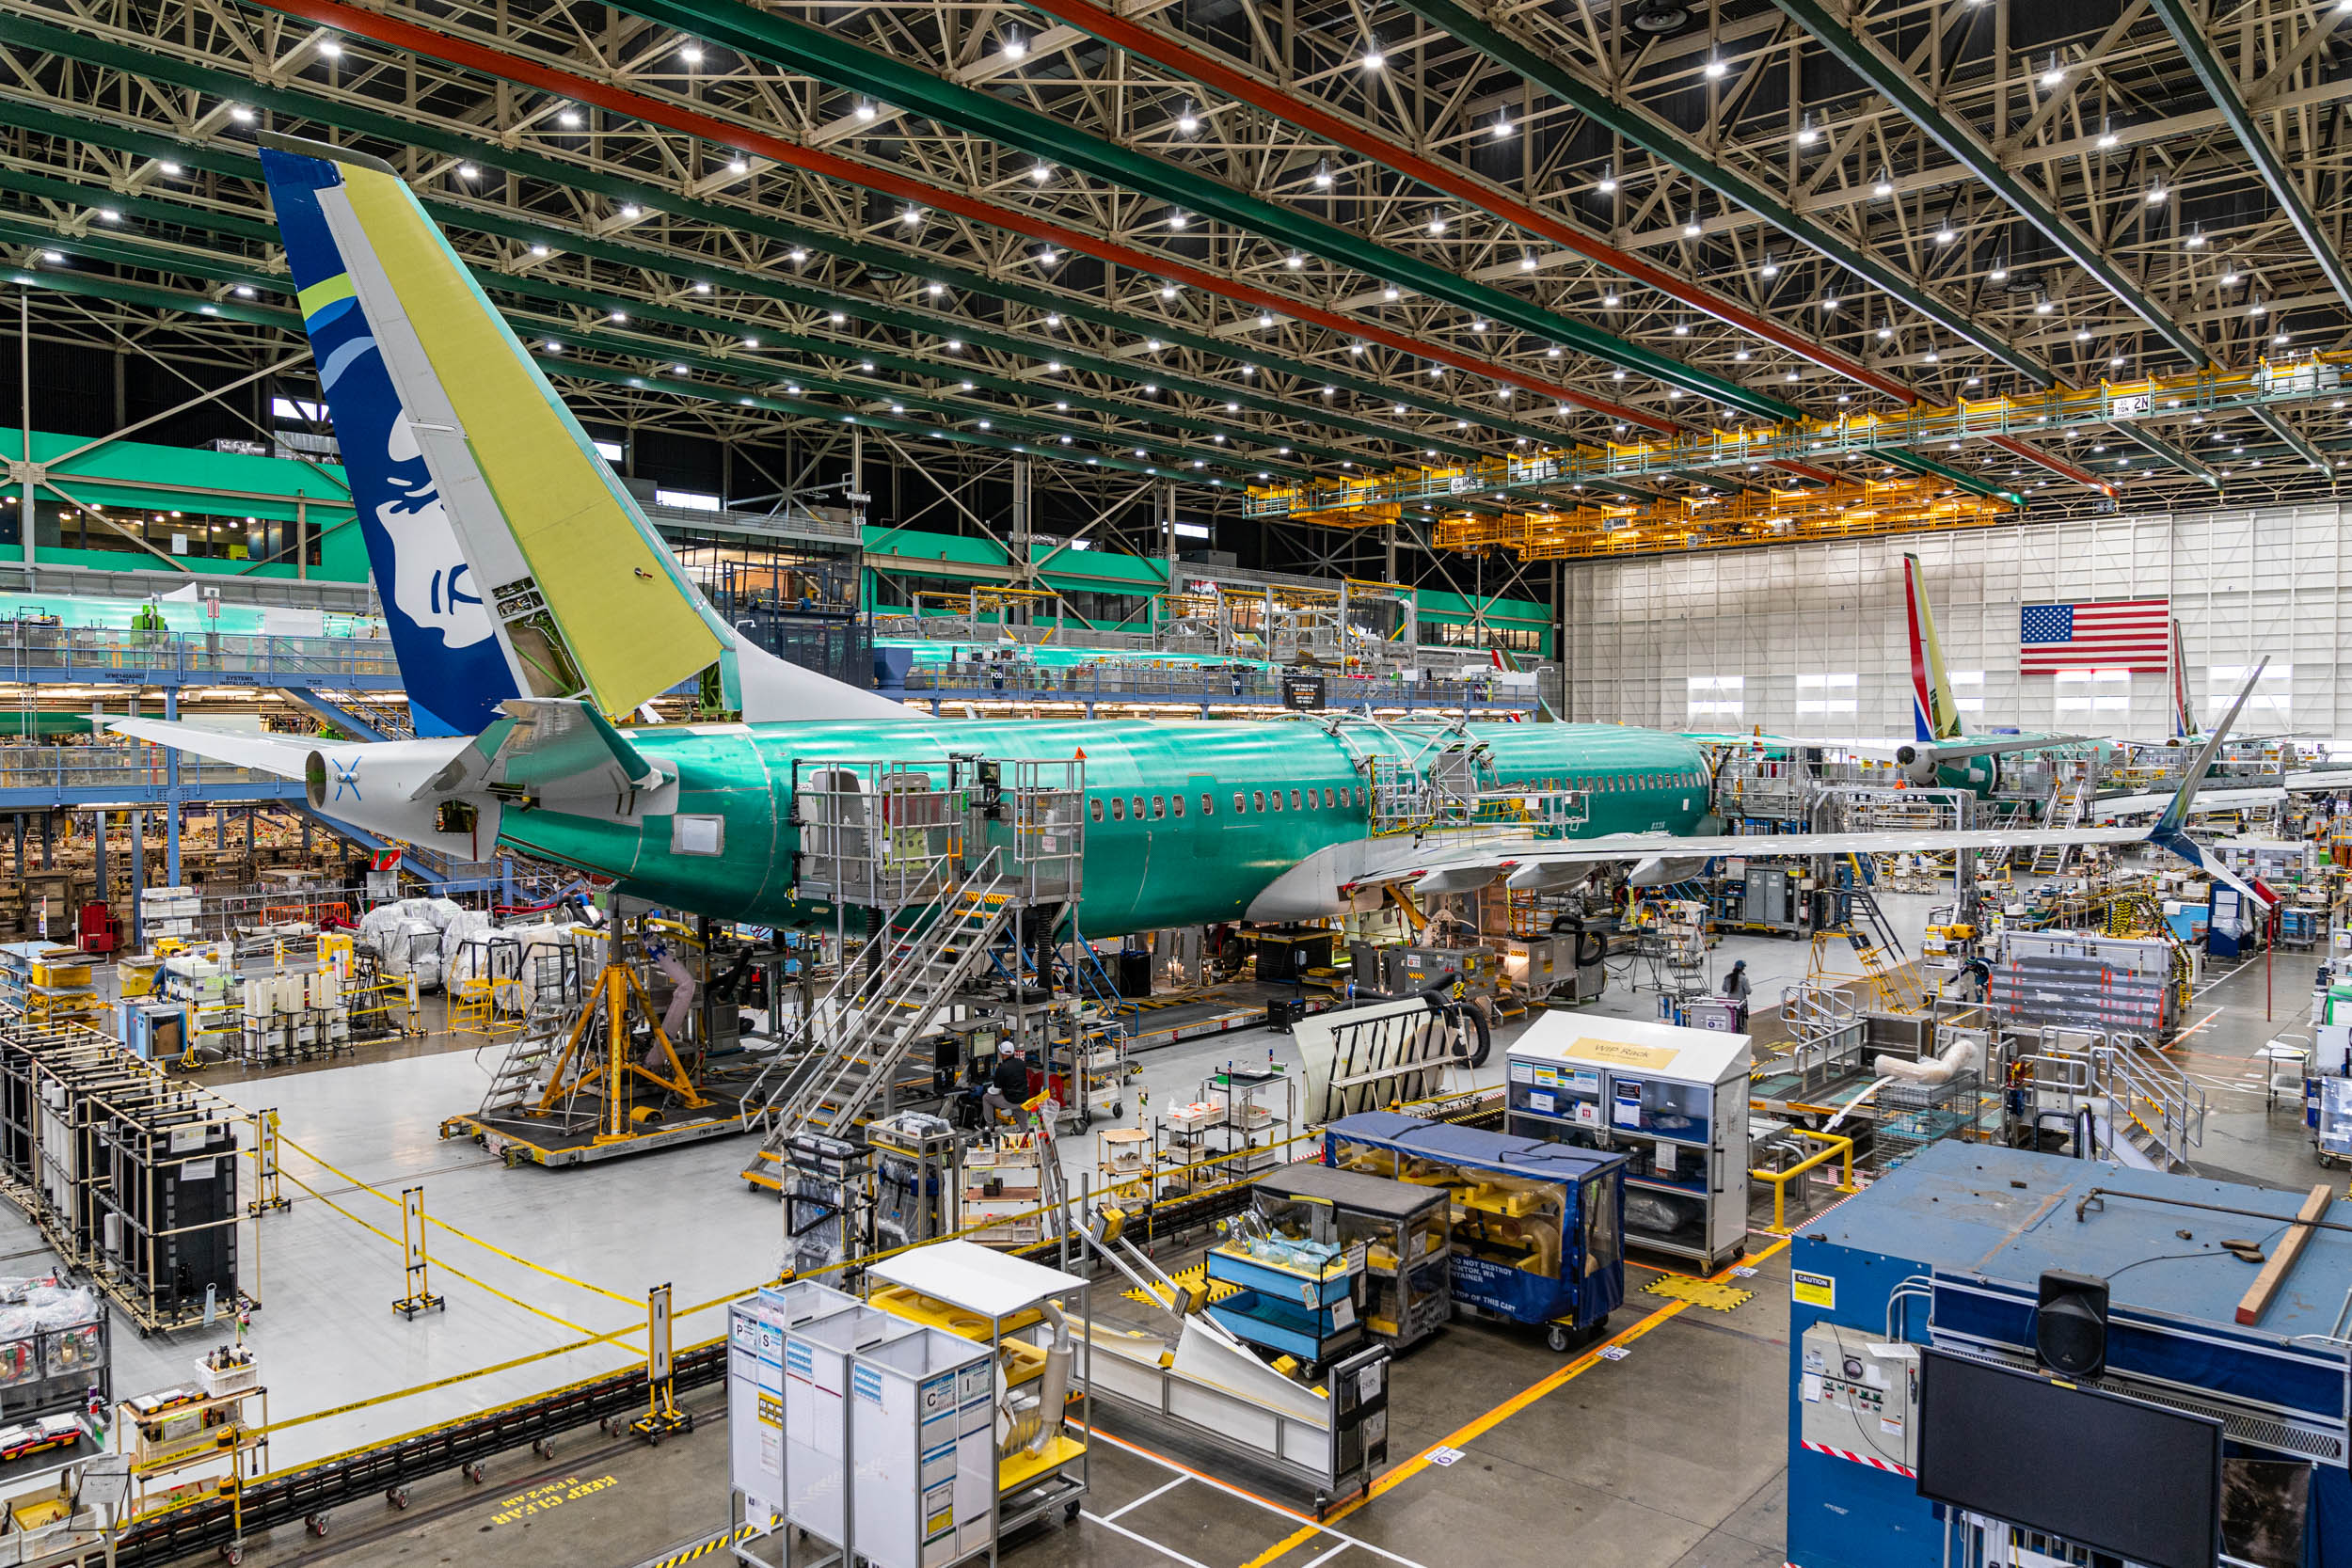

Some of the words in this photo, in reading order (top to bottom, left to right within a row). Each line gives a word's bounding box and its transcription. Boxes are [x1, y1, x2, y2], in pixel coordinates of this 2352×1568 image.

[2135, 397, 2149, 409] 2N
[1595, 1044, 1618, 1053] WIP
[1620, 1047, 1648, 1057] Rack
[1463, 1259, 1478, 1267] NOT
[1481, 1262, 1513, 1276] DESTROY
[1798, 1275, 1827, 1287] CAUTION
[1483, 1296, 1499, 1307] THIS
[1501, 1302, 1516, 1312] CART
[737, 1324, 743, 1336] P
[762, 1335, 770, 1347] S
[927, 1392, 936, 1407] C
[140, 1458, 162, 1469] Caution
[185, 1448, 200, 1456] Enter
[566, 1475, 618, 1500] KEEP
[142, 1507, 163, 1518] Caution
[186, 1496, 201, 1506] Enter
[501, 1495, 526, 1508] AM
[490, 1496, 564, 1525] CLEAR
